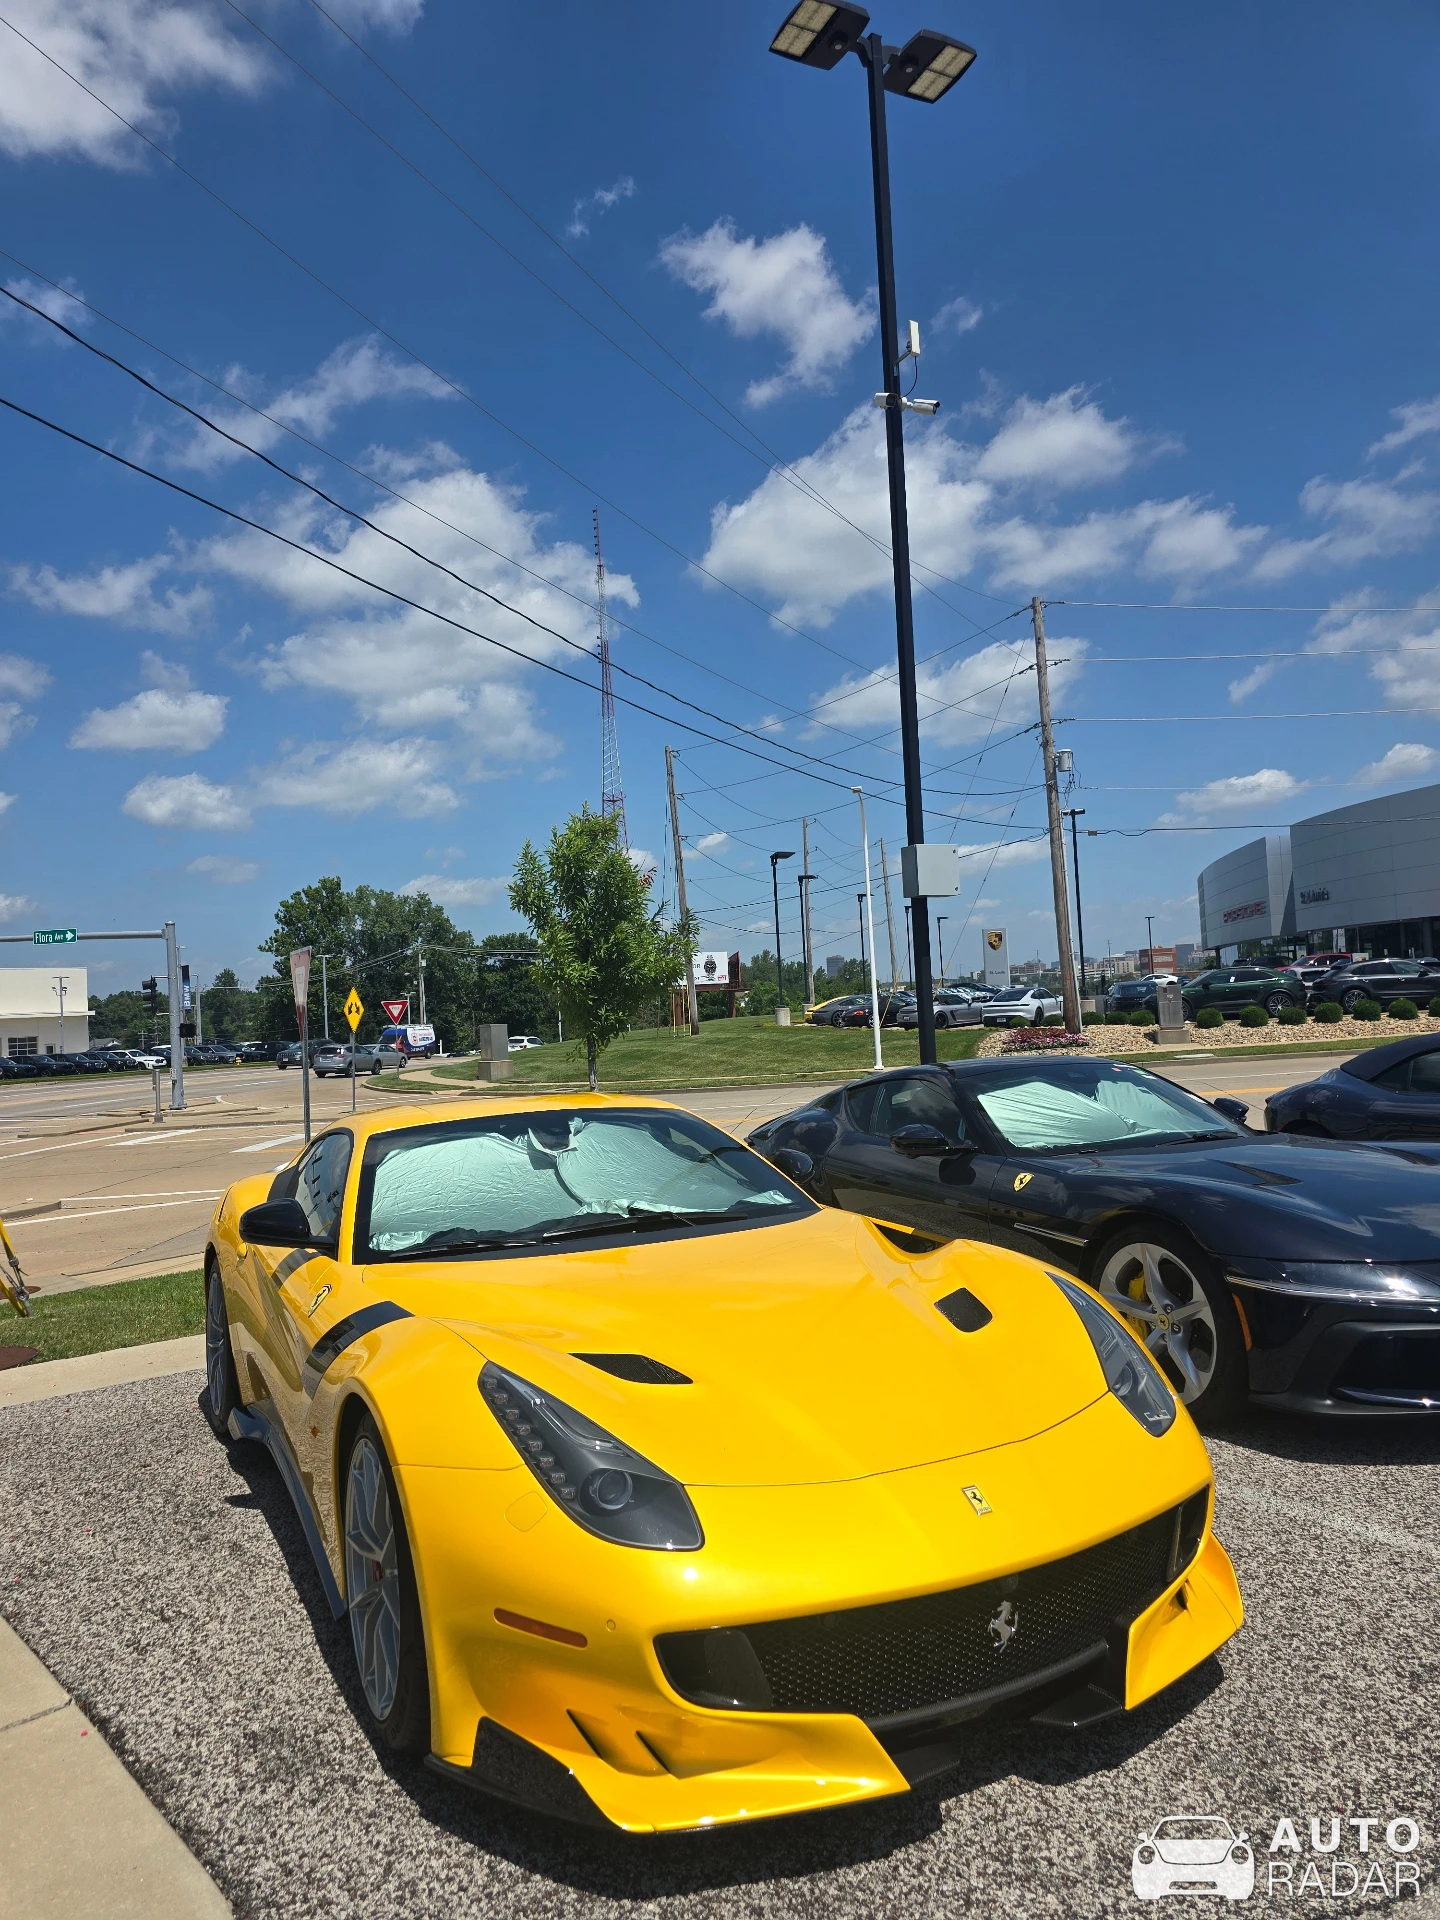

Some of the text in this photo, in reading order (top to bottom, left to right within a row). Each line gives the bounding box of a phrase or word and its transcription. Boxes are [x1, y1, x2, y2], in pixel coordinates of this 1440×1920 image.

[1223, 900, 1266, 923] PORSCHE
[35, 932, 64, 944] Flora Ave
[183, 985, 191, 1007] BMW
